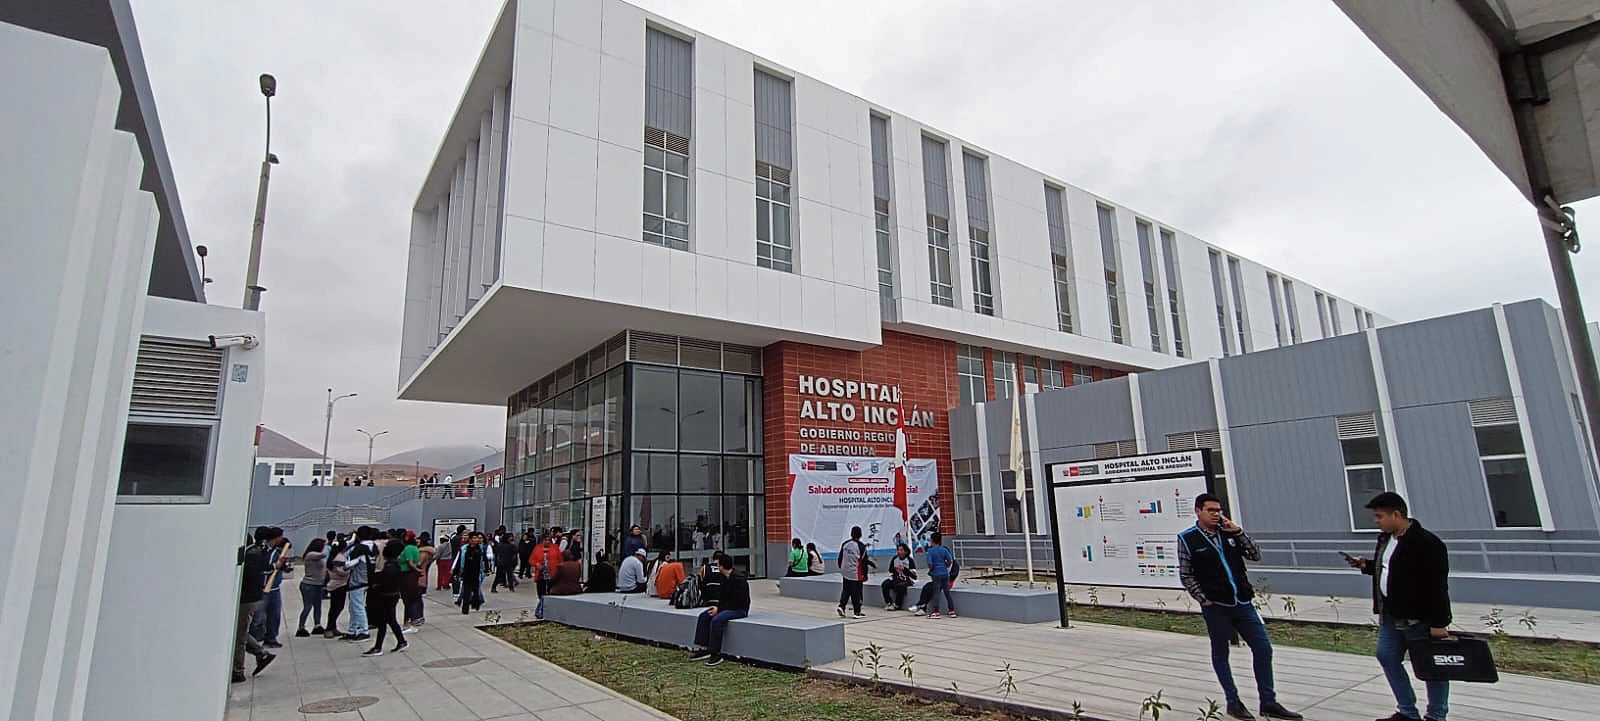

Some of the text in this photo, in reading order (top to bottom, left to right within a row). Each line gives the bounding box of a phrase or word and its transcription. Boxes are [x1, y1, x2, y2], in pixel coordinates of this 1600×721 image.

[800, 375, 900, 403] HOSPITAL
[800, 400, 856, 422] ALTO
[800, 427, 916, 443] GOBIERNO REGIOL
[801, 443, 876, 456] DE AREQUIPA
[1104, 460, 1139, 469] HOSPITAL
[1141, 458, 1160, 466] ALTO
[808, 485, 833, 494] Salud
[1433, 655, 1464, 663] SKP
